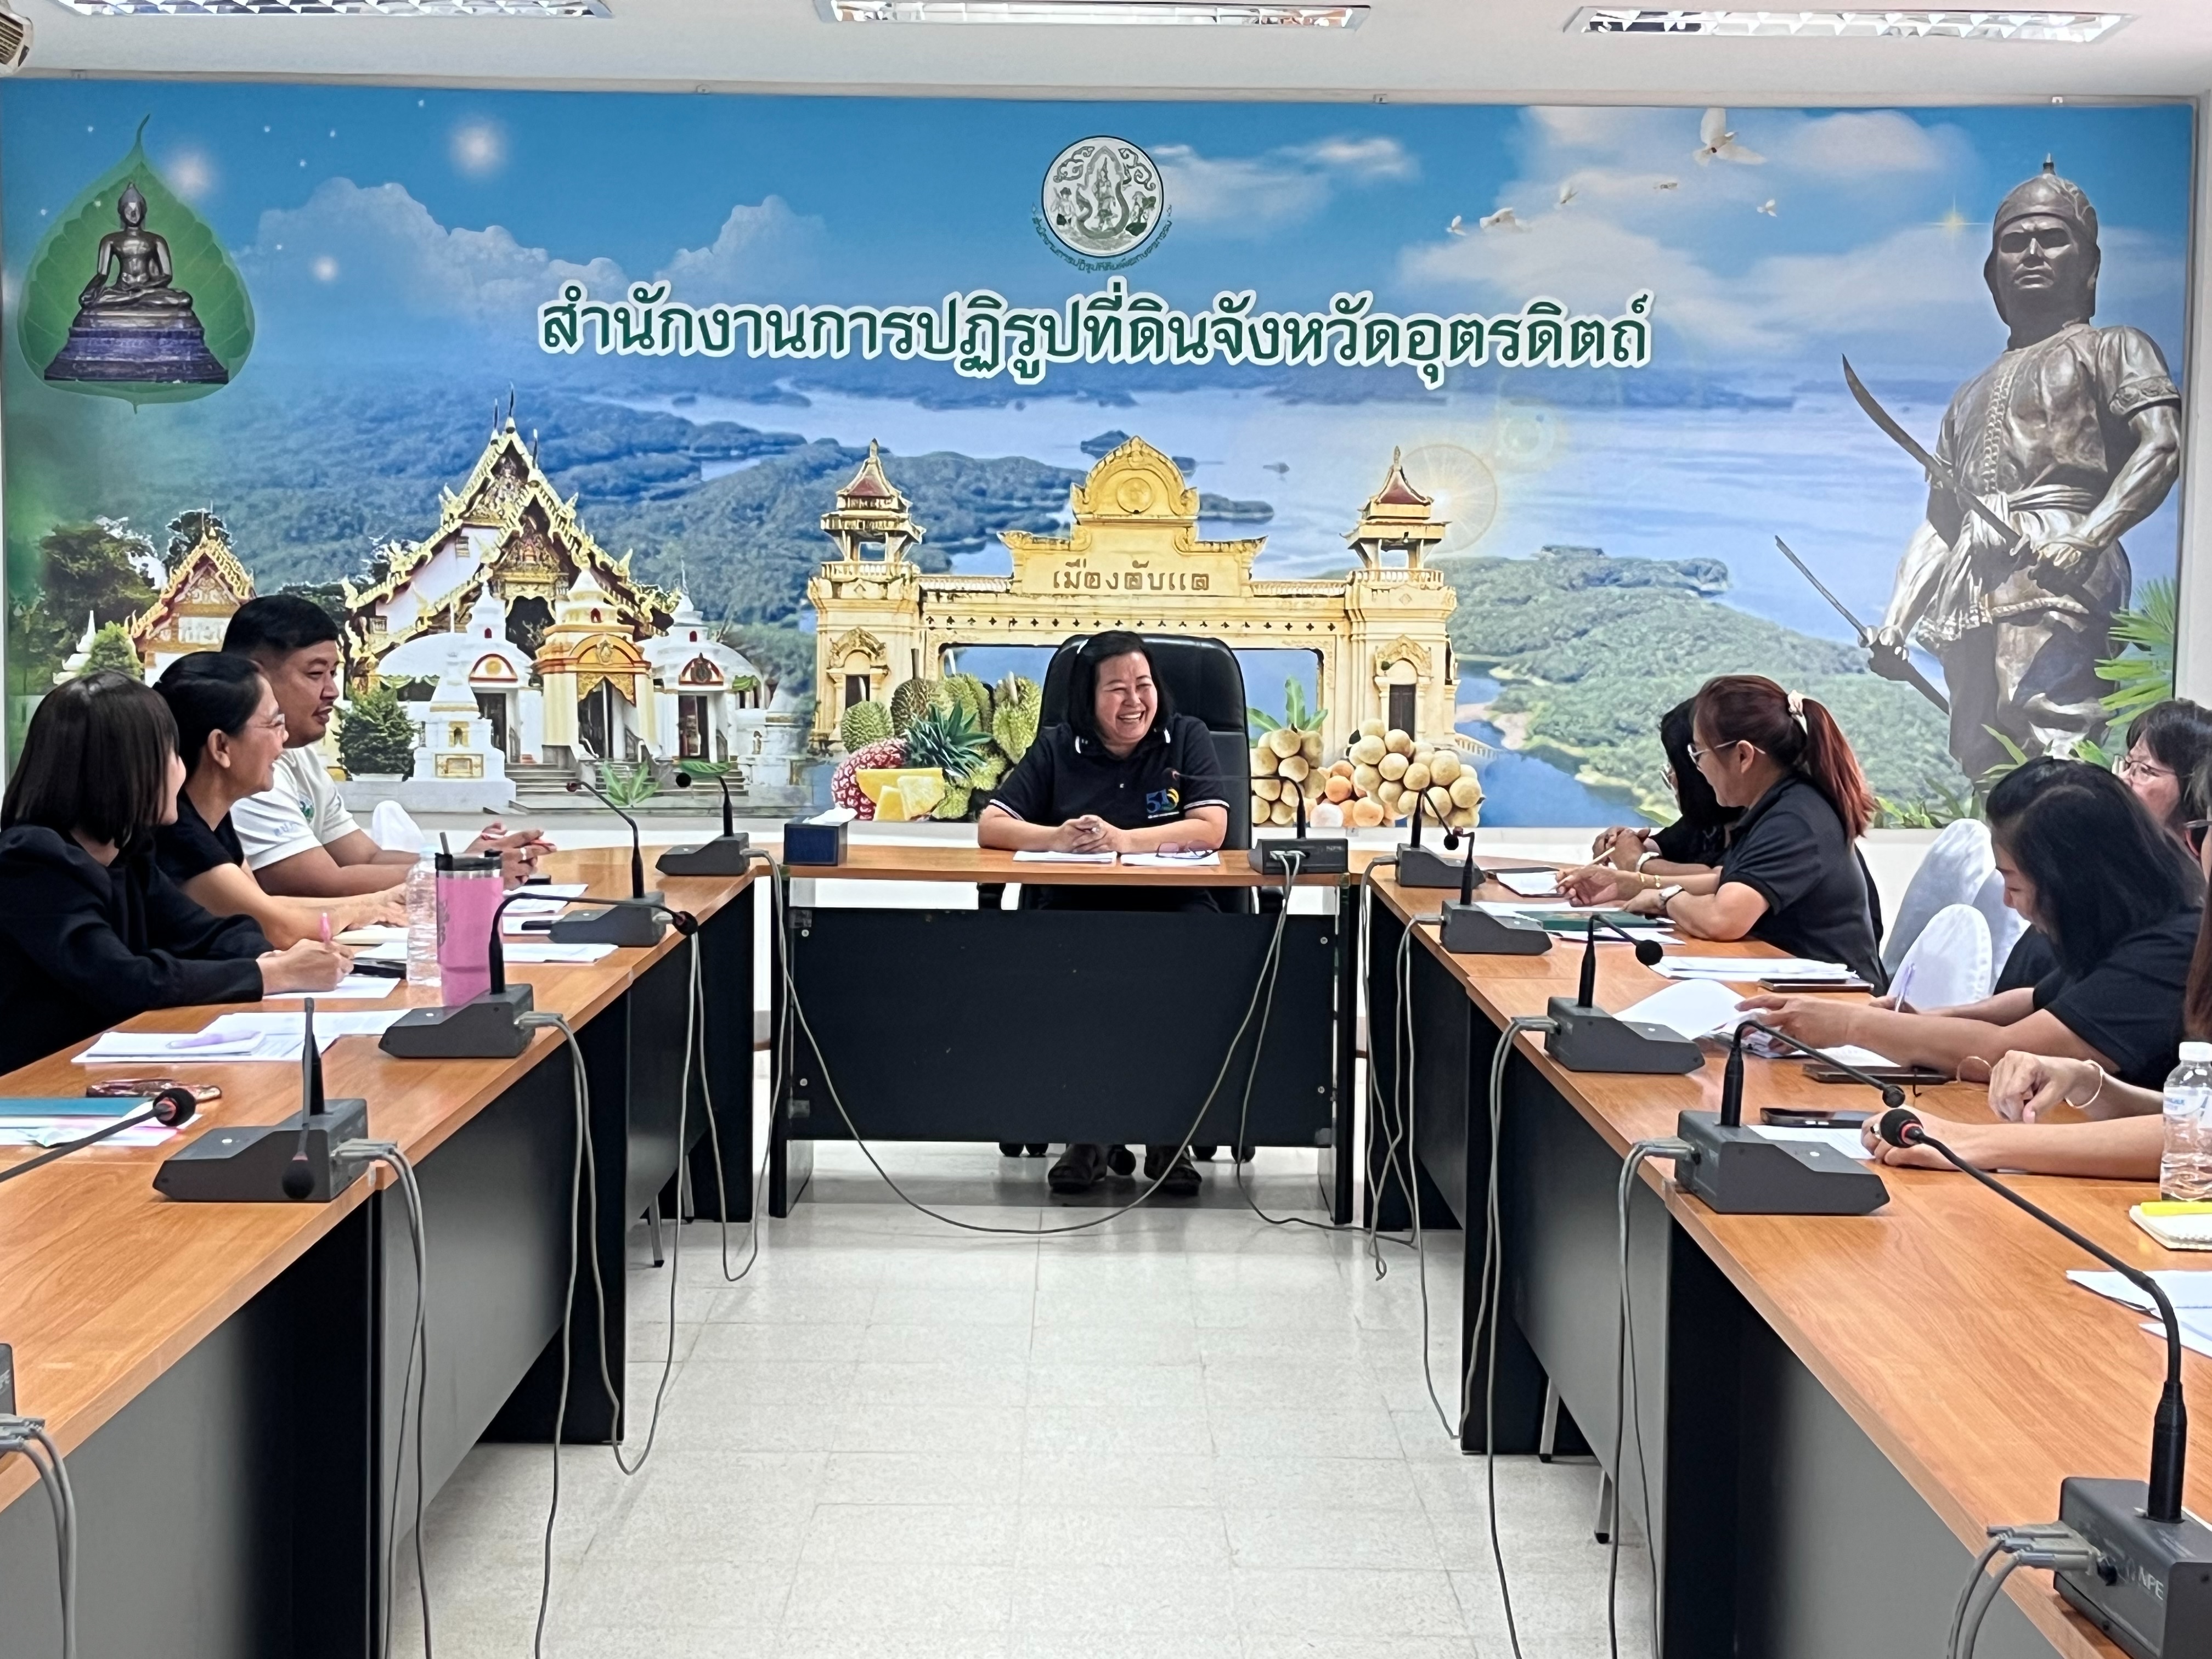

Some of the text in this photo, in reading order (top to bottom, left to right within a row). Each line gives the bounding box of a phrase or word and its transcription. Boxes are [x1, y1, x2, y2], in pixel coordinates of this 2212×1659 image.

[542, 281, 1649, 384] สำนักงานการปฏิรูปที่ดินจังหวัดอุตรดิตถ์
